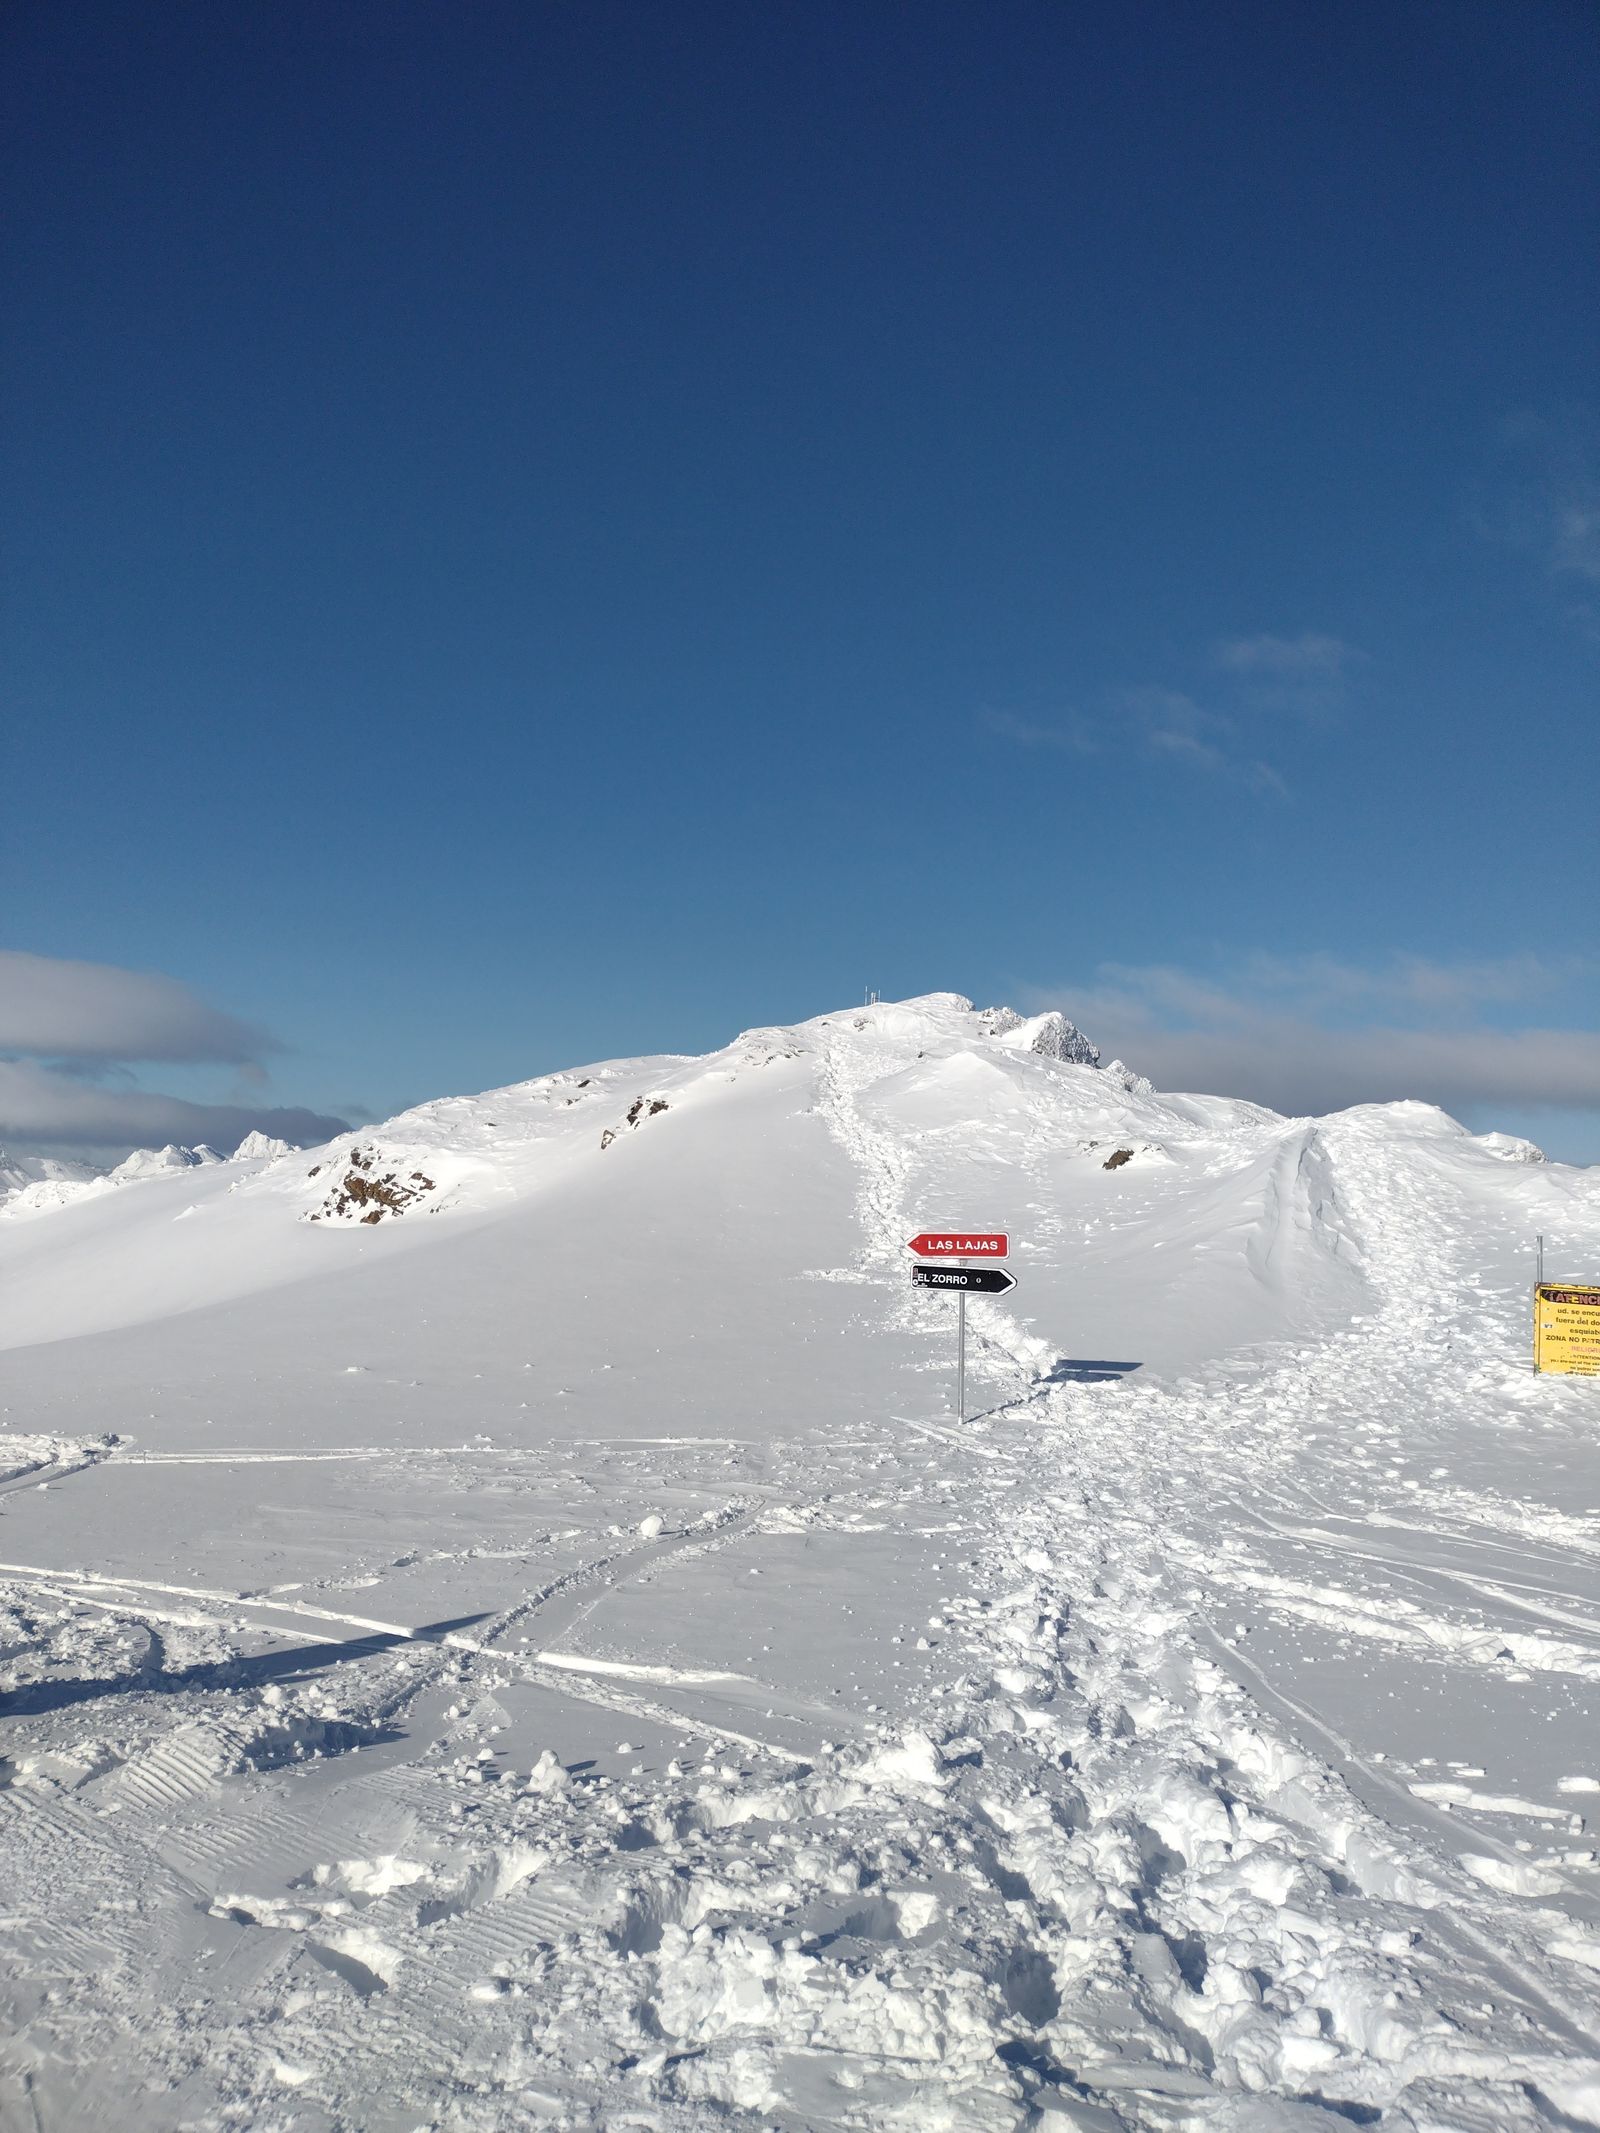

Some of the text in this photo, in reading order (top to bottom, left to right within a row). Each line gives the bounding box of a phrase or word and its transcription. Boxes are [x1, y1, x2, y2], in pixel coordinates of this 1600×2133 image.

[927, 1240, 998, 1250] LAS LAJAS
[917, 1273, 968, 1285] EL ZORRO
[1577, 1317, 1588, 1325] del
